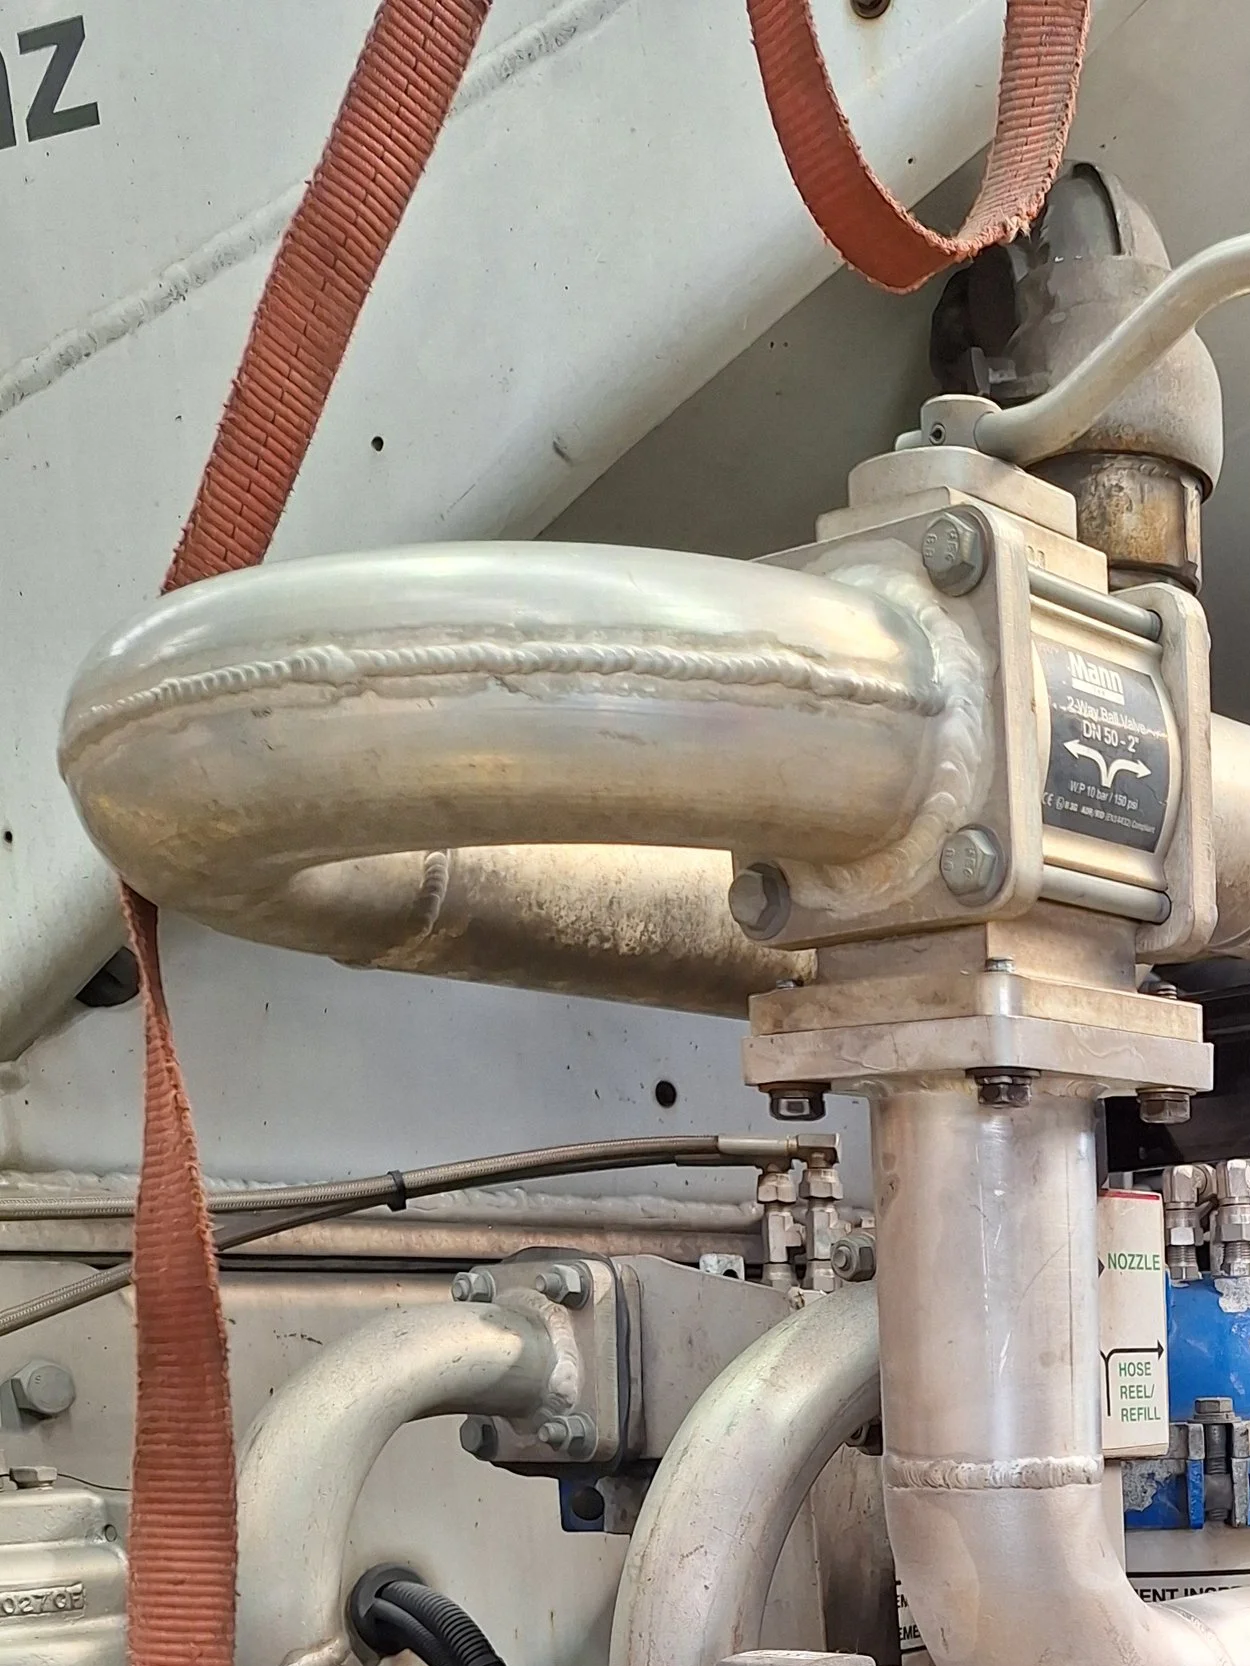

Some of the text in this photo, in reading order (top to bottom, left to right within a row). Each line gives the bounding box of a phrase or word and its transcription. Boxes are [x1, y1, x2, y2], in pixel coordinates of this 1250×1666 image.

[1067, 651, 1124, 693] Mann
[1066, 696, 1148, 735] 2-Way Ball Valve
[1082, 719, 1101, 741] DN
[1103, 727, 1119, 747] 50
[1087, 786, 1096, 799] 10
[1096, 788, 1109, 801] bar
[1114, 794, 1127, 807] 150
[1107, 1252, 1161, 1271] NOZZLE
[1118, 1361, 1152, 1377] HOSE
[1120, 1384, 1155, 1400] REEL/
[1121, 1406, 1161, 1423] REFILL
